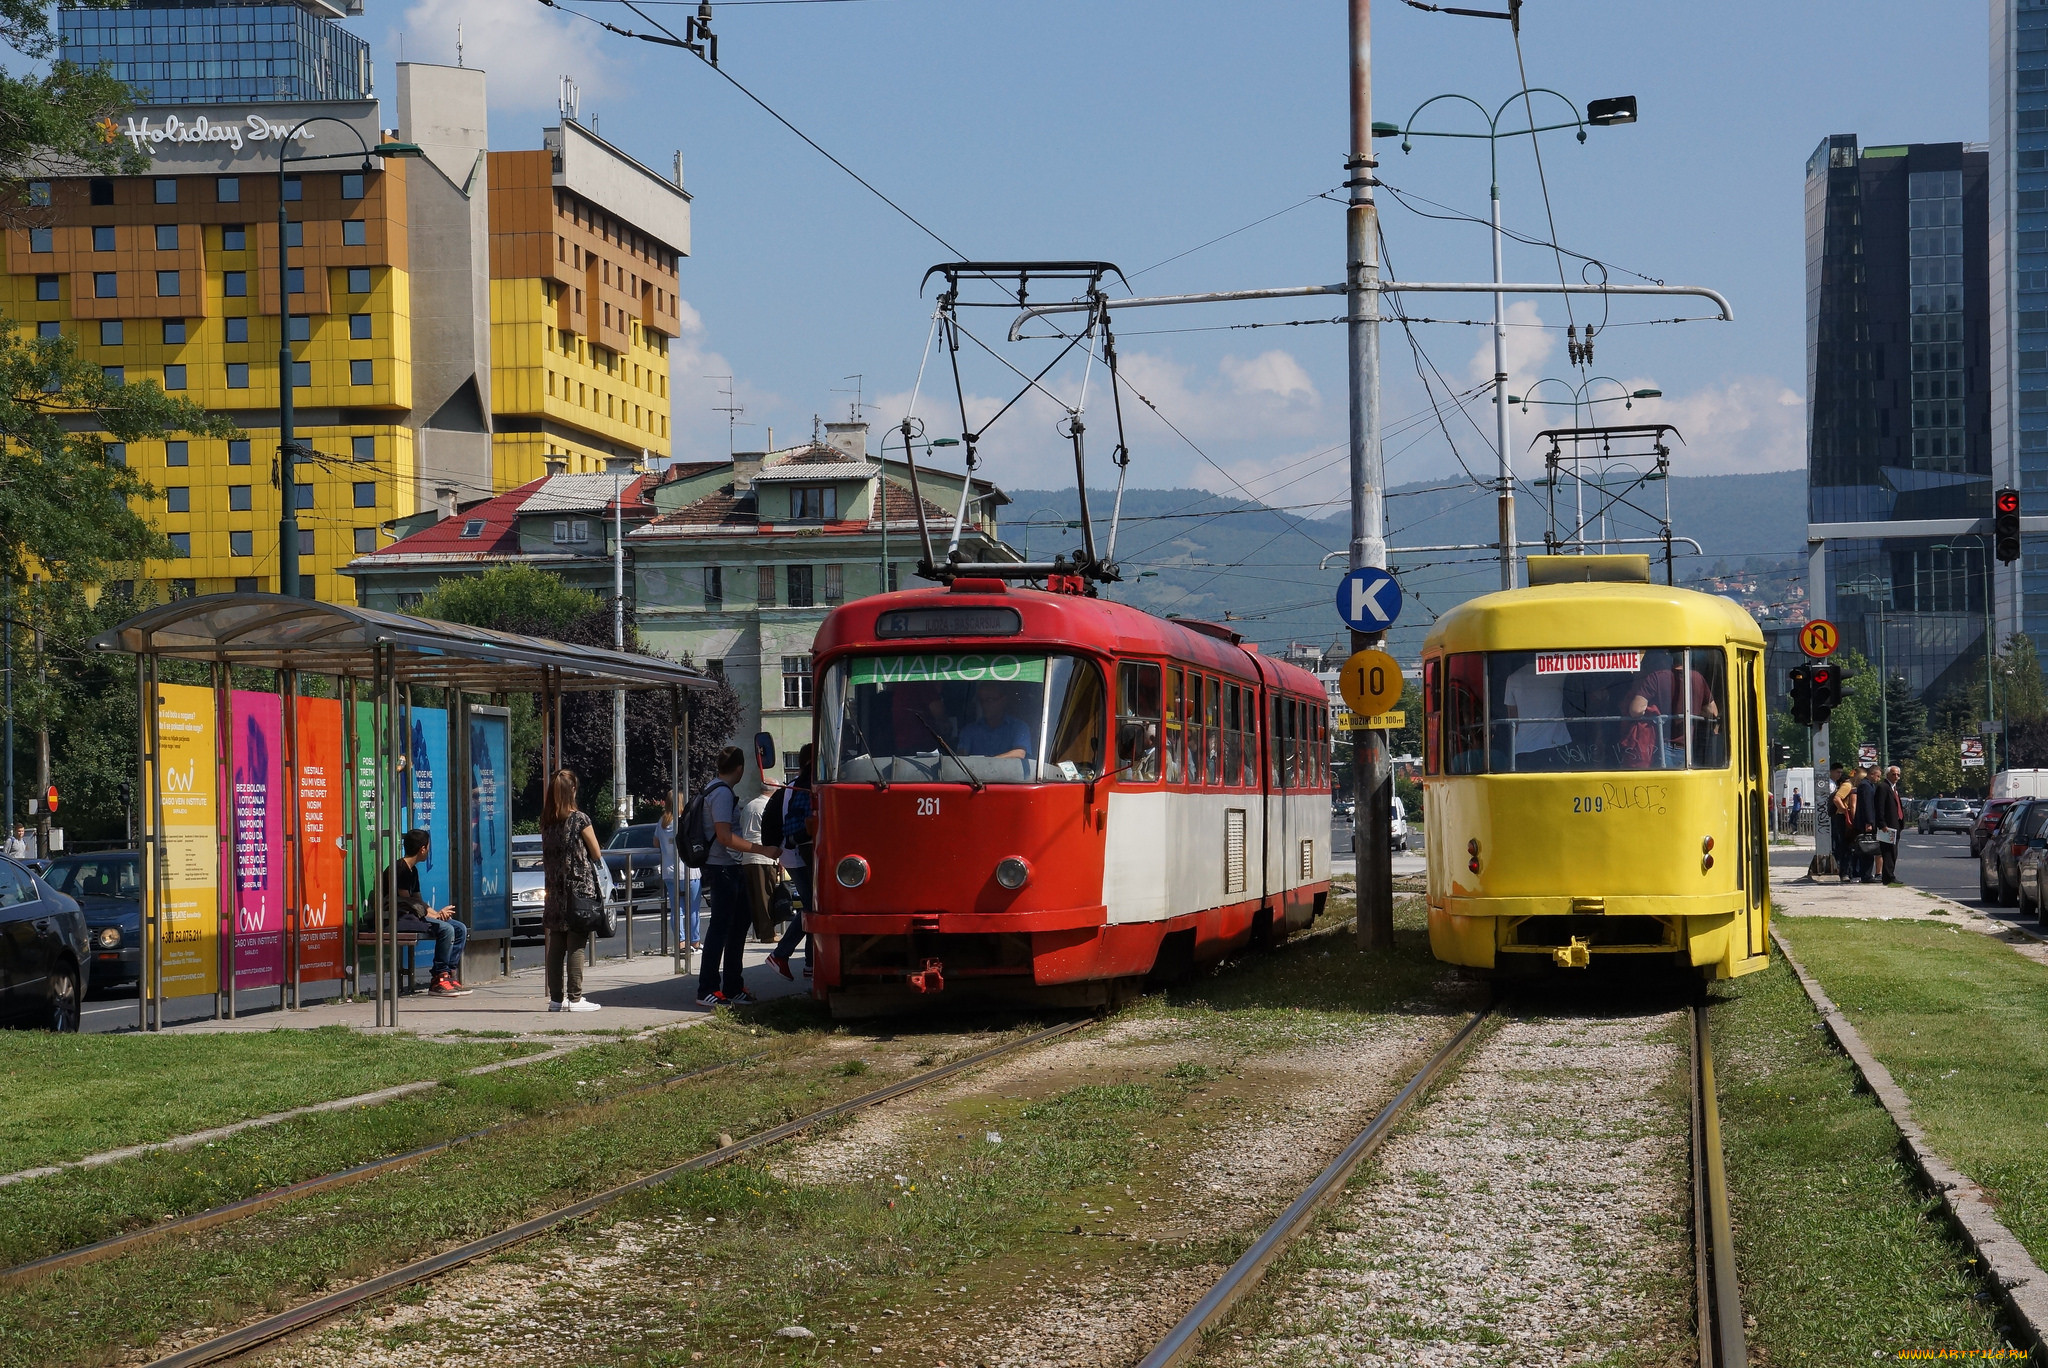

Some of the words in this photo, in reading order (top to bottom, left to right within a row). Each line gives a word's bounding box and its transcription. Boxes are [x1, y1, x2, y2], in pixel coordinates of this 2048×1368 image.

[124, 114, 243, 154] Holiday
[246, 114, 315, 141] Inn
[1351, 578, 1391, 622] K
[1537, 653, 1565, 673] DRŽI
[1566, 652, 1639, 672] ODSTOJANJE
[872, 654, 1022, 684] MARGO
[1357, 666, 1385, 696] 10
[1339, 717, 1349, 726] NA
[1373, 716, 1382, 725] OD
[303, 766, 324, 775] NESTALE
[301, 778, 308, 787] SU
[309, 778, 314, 787] MI
[314, 778, 326, 787] VENE
[236, 783, 246, 793] BEZ
[246, 783, 266, 793] BOLOVA
[316, 789, 327, 798] OPET
[241, 795, 265, 804] OTICANJA
[1573, 796, 1603, 813] 209
[307, 801, 322, 810] NOSIM
[917, 797, 940, 816] 261
[238, 807, 252, 817] NOGU
[252, 807, 266, 817] SADA
[305, 812, 323, 821] SUKNJE
[240, 819, 264, 828] NAPOKON
[241, 831, 255, 840] MOGU
[256, 831, 264, 840] DA
[236, 843, 254, 853] BUDEM
[254, 843, 260, 852] TU
[261, 843, 268, 851] ZA
[239, 855, 250, 864] ONE
[250, 855, 265, 864] SVOJE
